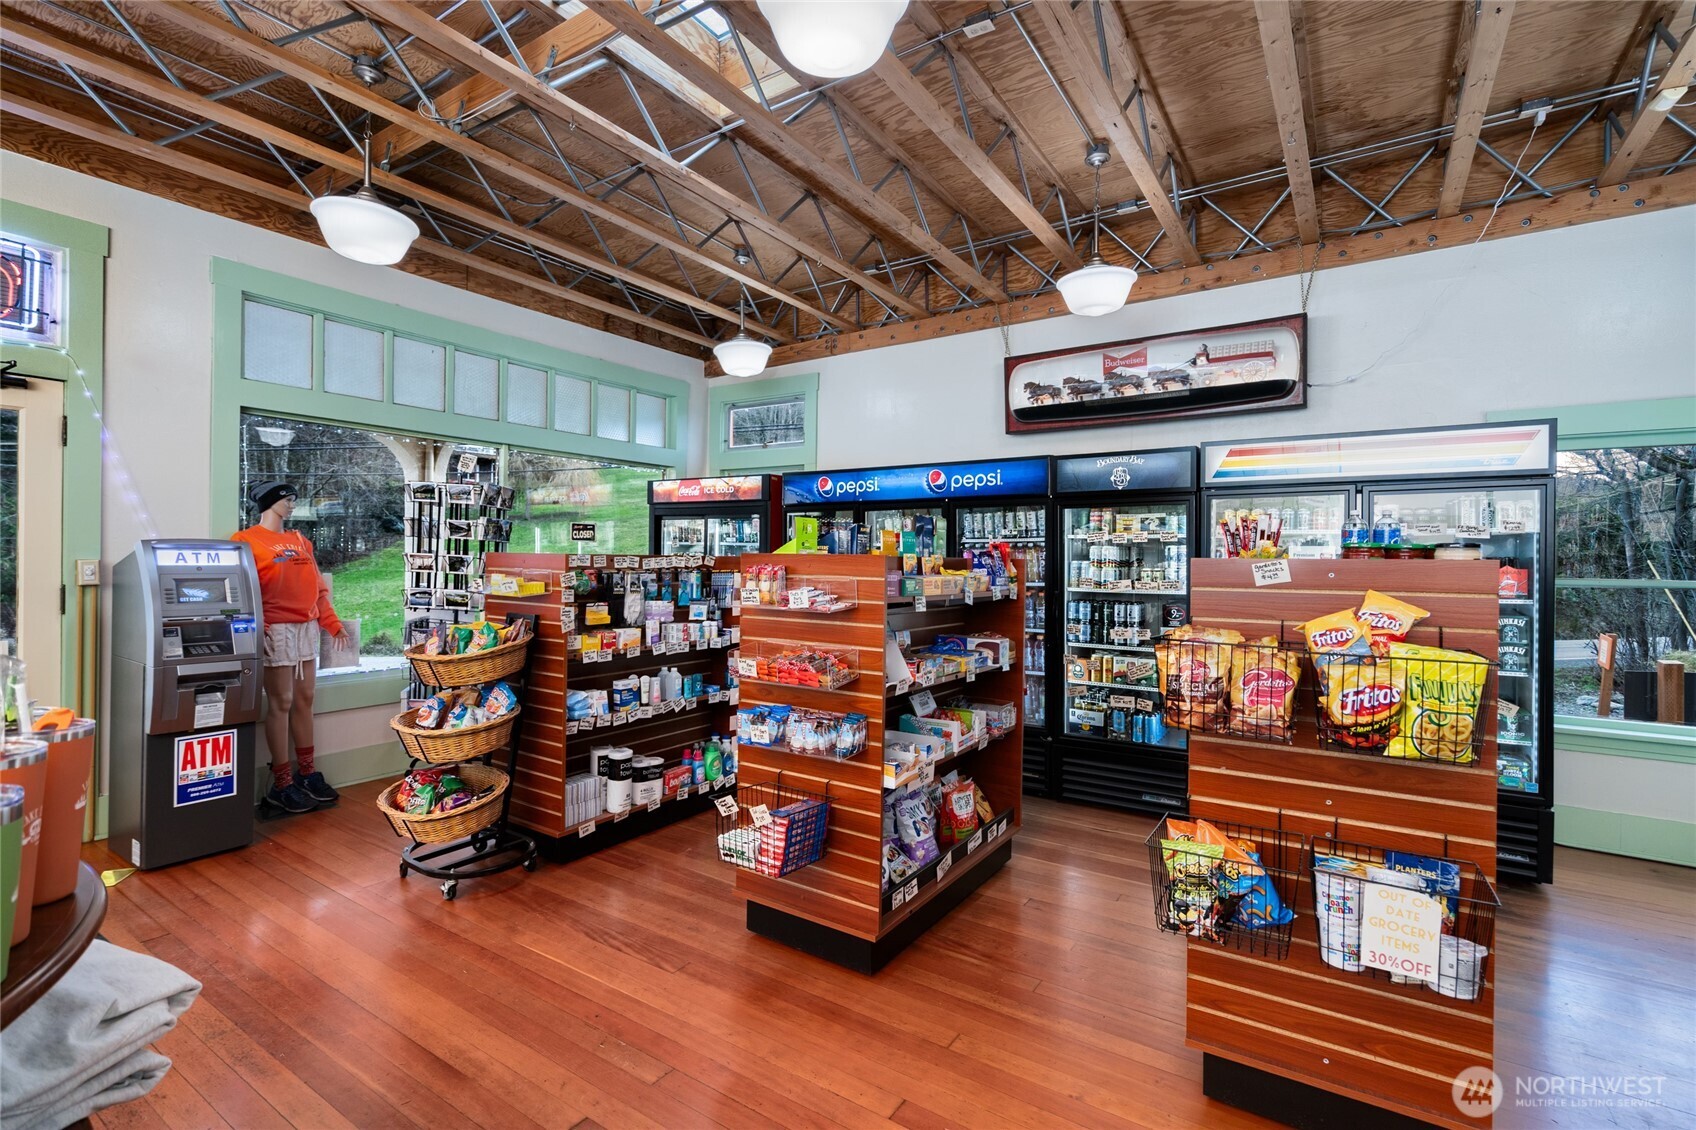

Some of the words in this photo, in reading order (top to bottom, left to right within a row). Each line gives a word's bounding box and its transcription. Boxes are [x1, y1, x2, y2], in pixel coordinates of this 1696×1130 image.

[1104, 356, 1146, 368] Budweiser
[1096, 456, 1130, 467] BOUNDARY
[1129, 455, 1146, 465] BAY
[836, 475, 880, 496] pepsi
[951, 469, 1003, 491] pepsi
[678, 484, 701, 498] Coca-Cola
[573, 530, 594, 539] CLOSED
[175, 552, 221, 564] ATM
[1359, 611, 1402, 631] Fritos
[1311, 628, 1354, 649] Fritos
[1339, 685, 1401, 715] Fritos
[1077, 714, 1096, 722] Corona
[181, 735, 231, 772] ATM
[1395, 864, 1437, 879] PLANTERS
[1378, 889, 1407, 904] OUT
[1412, 897, 1432, 911] OF
[1386, 905, 1420, 922] DATE
[1368, 916, 1437, 942] GROCERY
[1381, 936, 1420, 954] ITEMS
